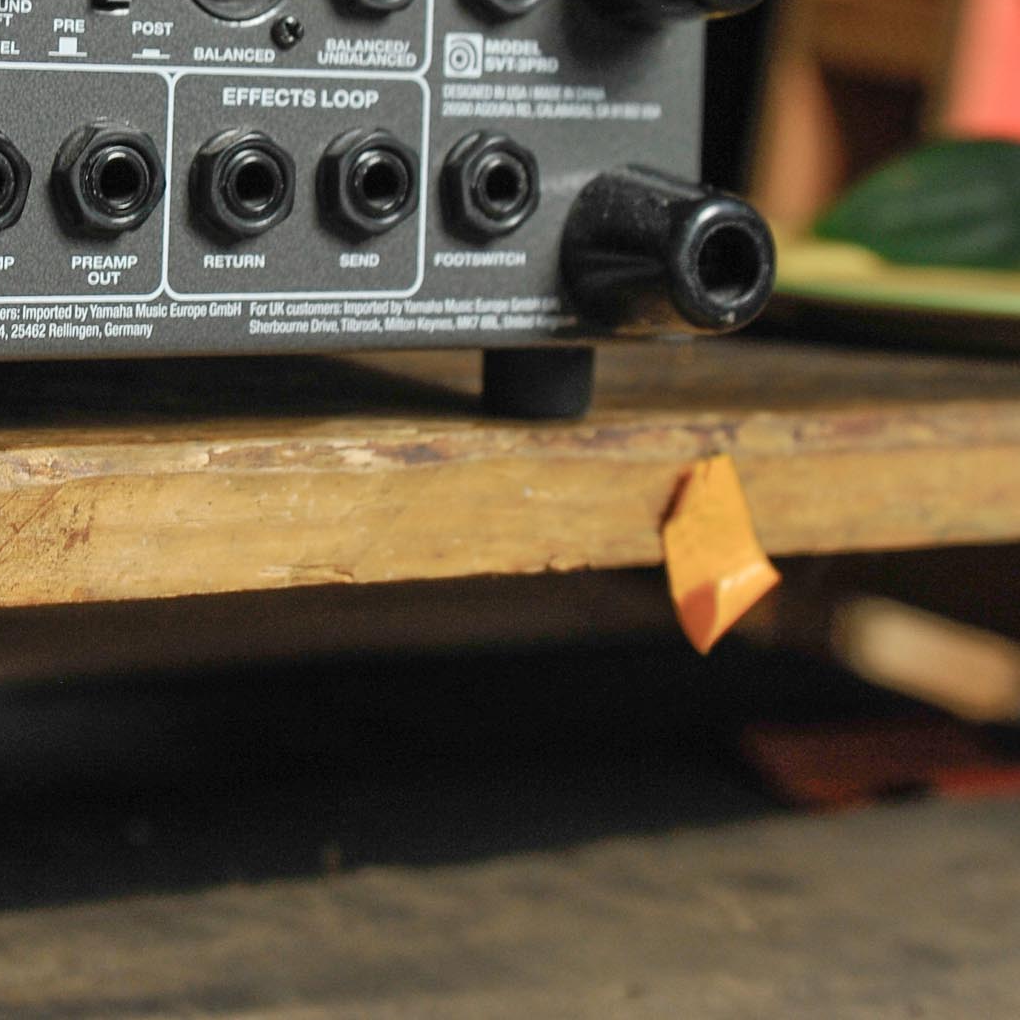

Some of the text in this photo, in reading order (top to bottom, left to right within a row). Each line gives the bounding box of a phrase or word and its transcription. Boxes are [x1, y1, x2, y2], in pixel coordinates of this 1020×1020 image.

[53, 18, 86, 33] PRE
[131, 21, 174, 37] POST
[326, 38, 410, 54] BALANCED/
[484, 38, 542, 56] MODEL
[193, 47, 276, 63] BALANCED
[317, 52, 417, 68] UNBALANCED
[222, 87, 379, 108] EFFECTS LOOP
[71, 255, 138, 270] PREAMP
[203, 254, 265, 269] RETURN
[339, 253, 381, 268] SEND
[434, 252, 527, 267] FOOTSWITCH
[87, 271, 121, 286] OUT
[22, 305, 72, 322] Imported
[75, 304, 88, 322] by
[89, 303, 133, 319] Yamaha
[135, 303, 167, 318] Music
[170, 302, 207, 320] Europe
[209, 301, 242, 316] GmbH
[249, 301, 267, 316] For
[269, 301, 284, 316] UK
[286, 300, 342, 316] customers:
[343, 300, 389, 316] Imported
[390, 300, 403, 316] by
[11, 324, 46, 339] 25462
[49, 323, 102, 340] Rellingen,
[104, 322, 153, 338] Germany
[249, 319, 309, 334] Sherbourne
[311, 318, 340, 333] Drive,
